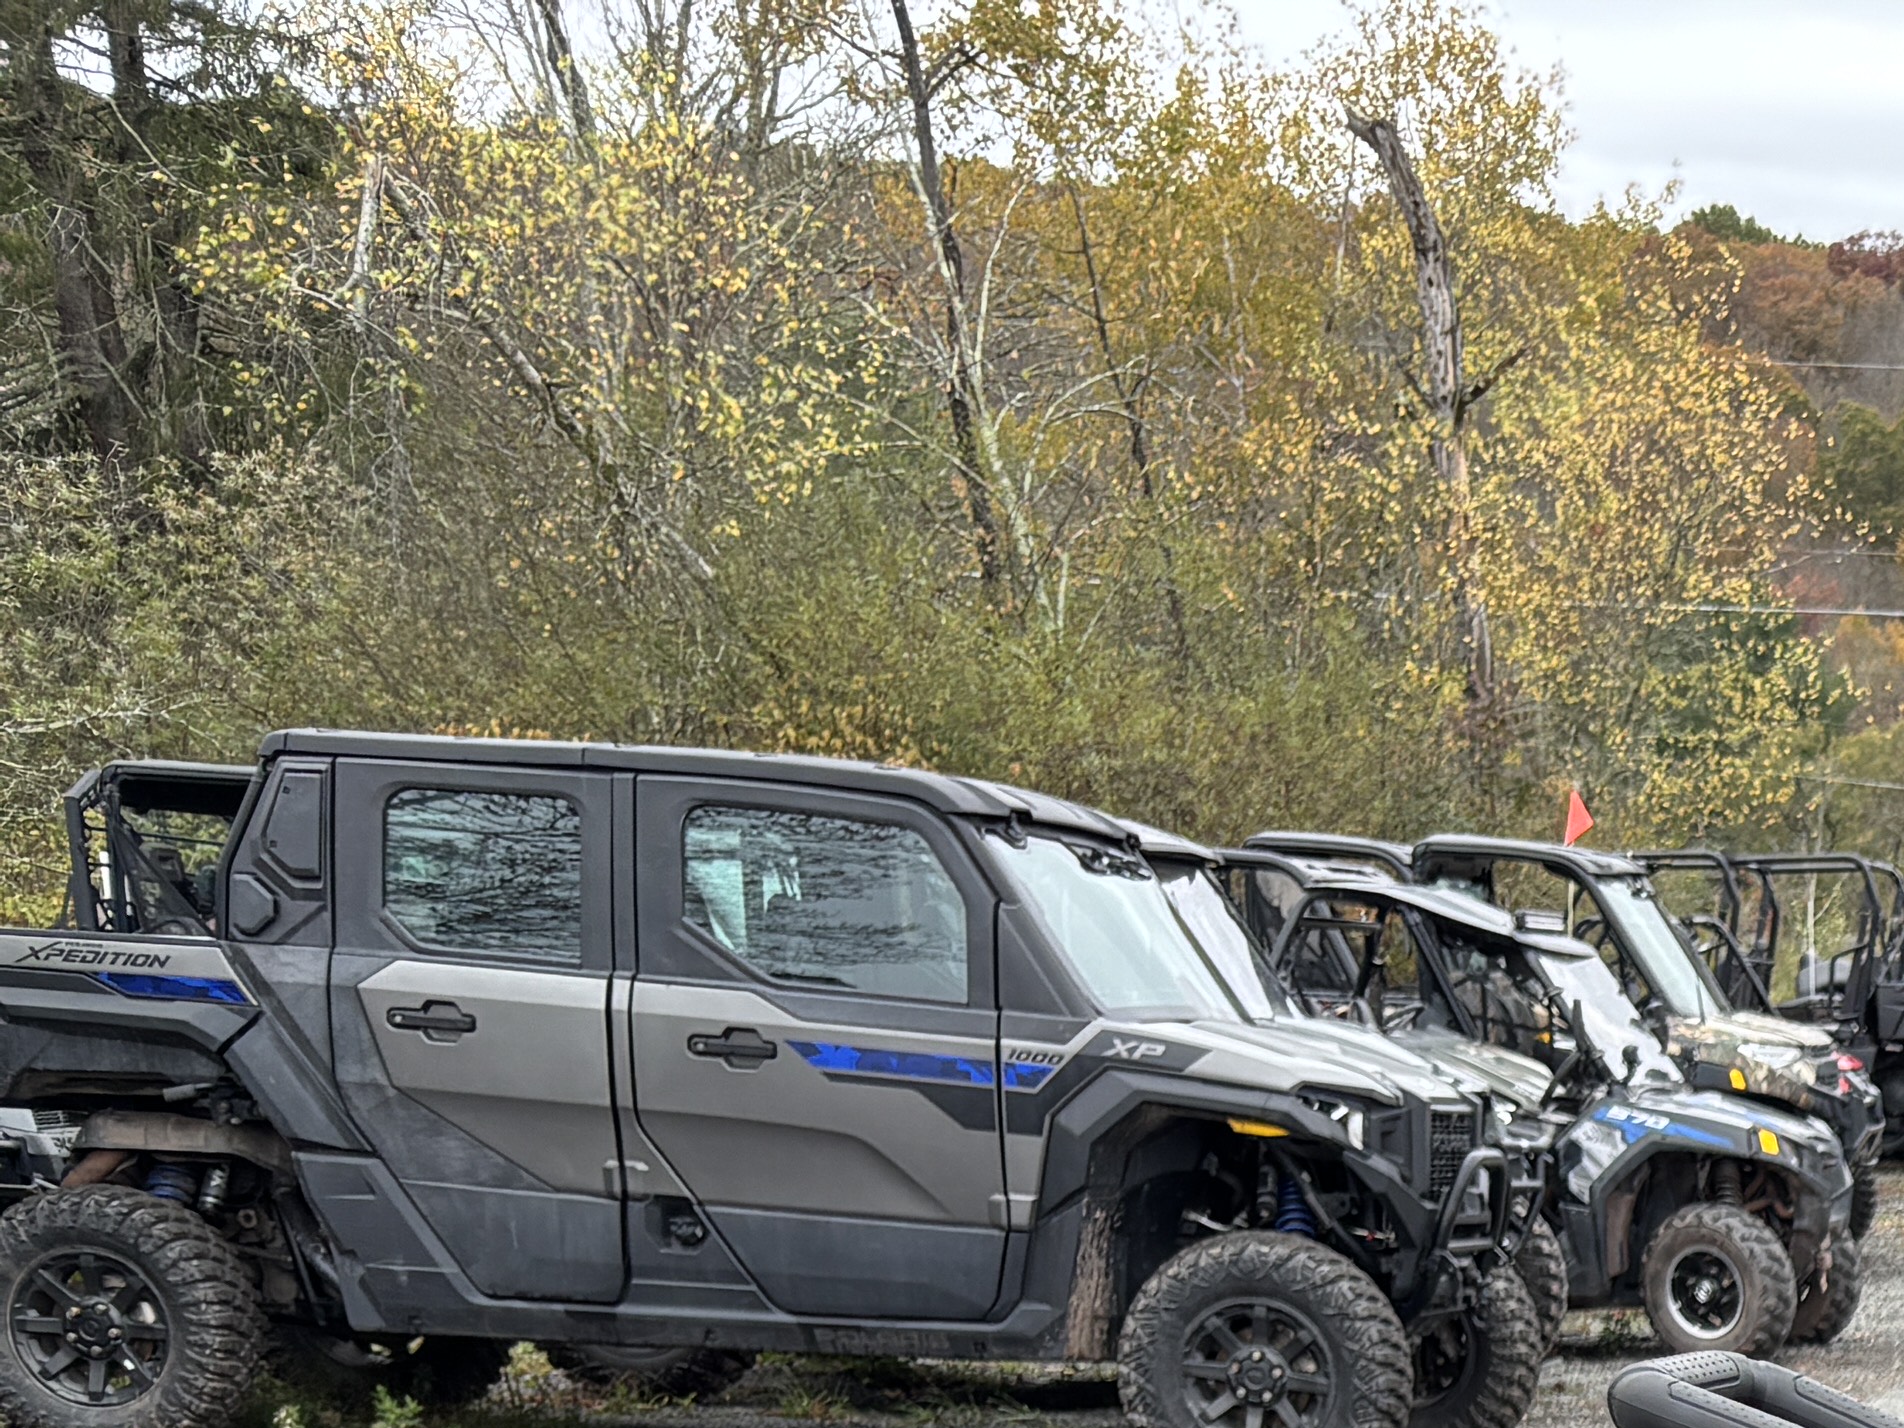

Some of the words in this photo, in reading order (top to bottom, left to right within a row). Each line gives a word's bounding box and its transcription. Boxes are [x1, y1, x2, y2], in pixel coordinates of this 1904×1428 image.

[14, 941, 171, 968] XPEDITION
[1009, 1049, 1065, 1065] 1000
[1102, 1036, 1166, 1060] XP
